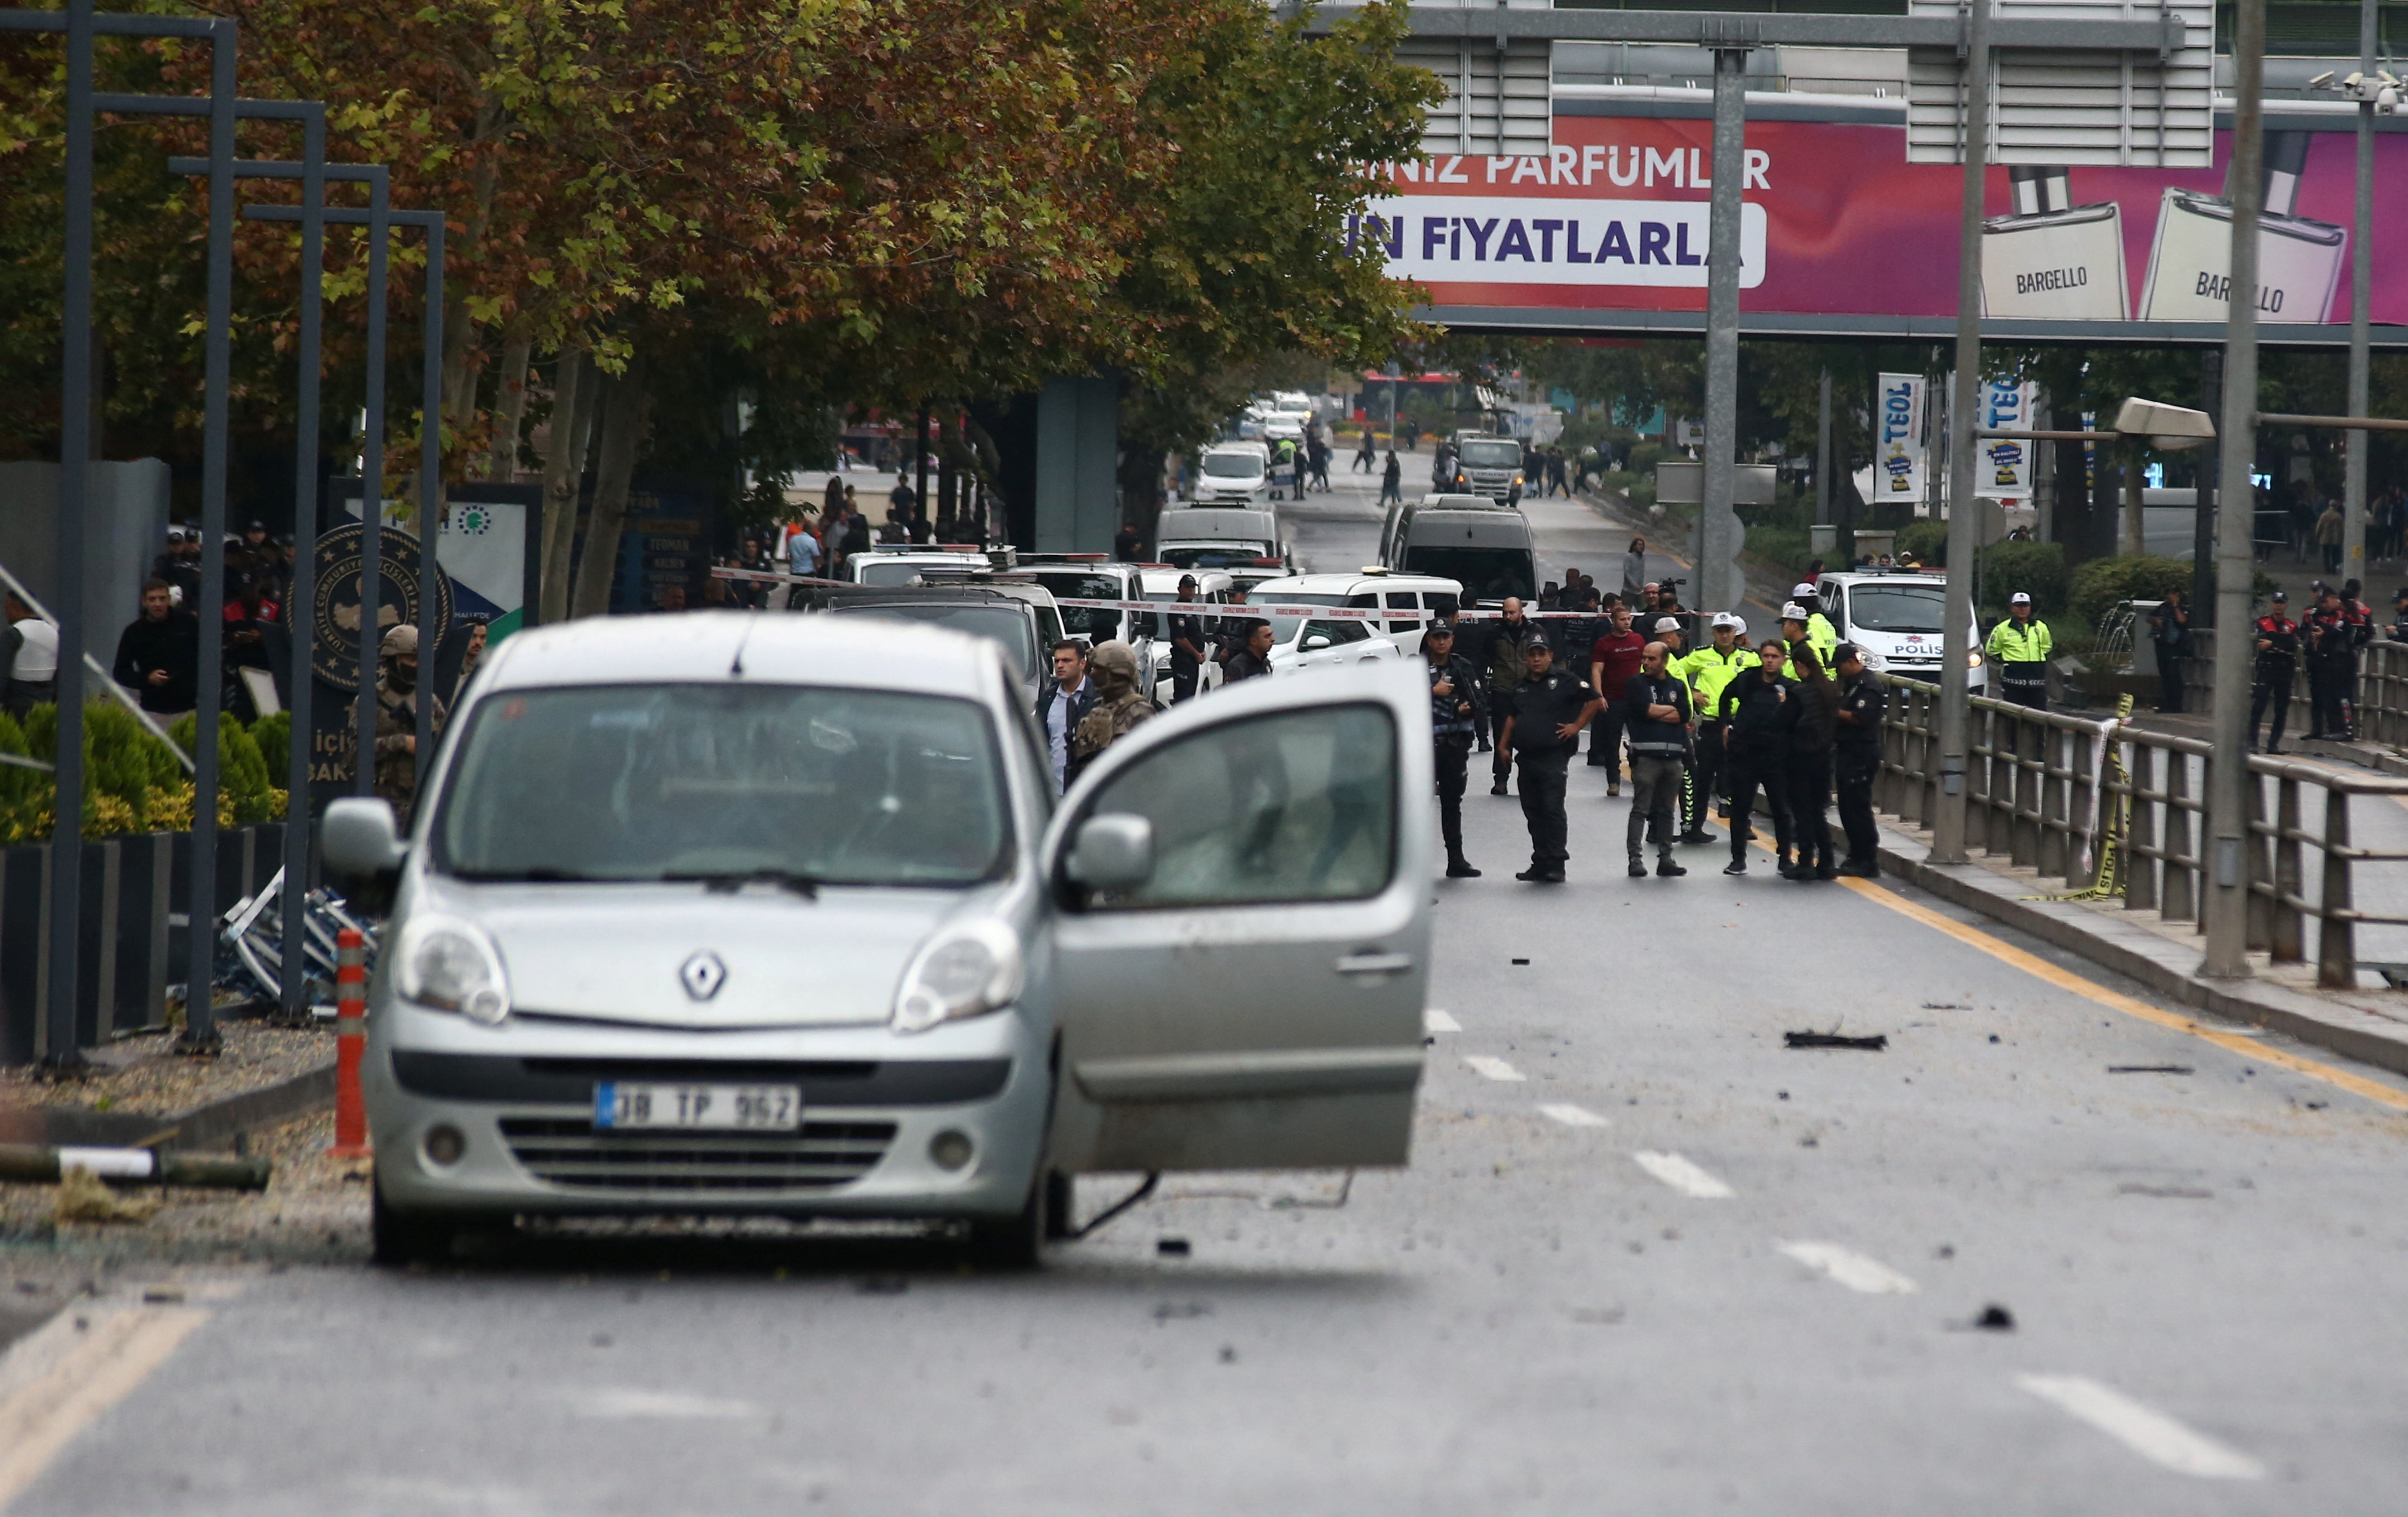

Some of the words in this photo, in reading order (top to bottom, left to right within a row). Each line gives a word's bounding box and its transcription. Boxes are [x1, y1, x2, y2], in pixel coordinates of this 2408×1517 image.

[1486, 145, 1771, 190] PARFÜMLR
[1423, 216, 1744, 266] FİYATLARL
[2017, 266, 2087, 294] BARGELLO
[2196, 272, 2284, 313] BARLO
[1884, 383, 1911, 444] TEOL
[1988, 374, 2020, 429] TEO
[316, 559, 363, 607] CUMHURİYE
[1895, 644, 1943, 655] POLİS
[316, 729, 345, 757] İÇİ
